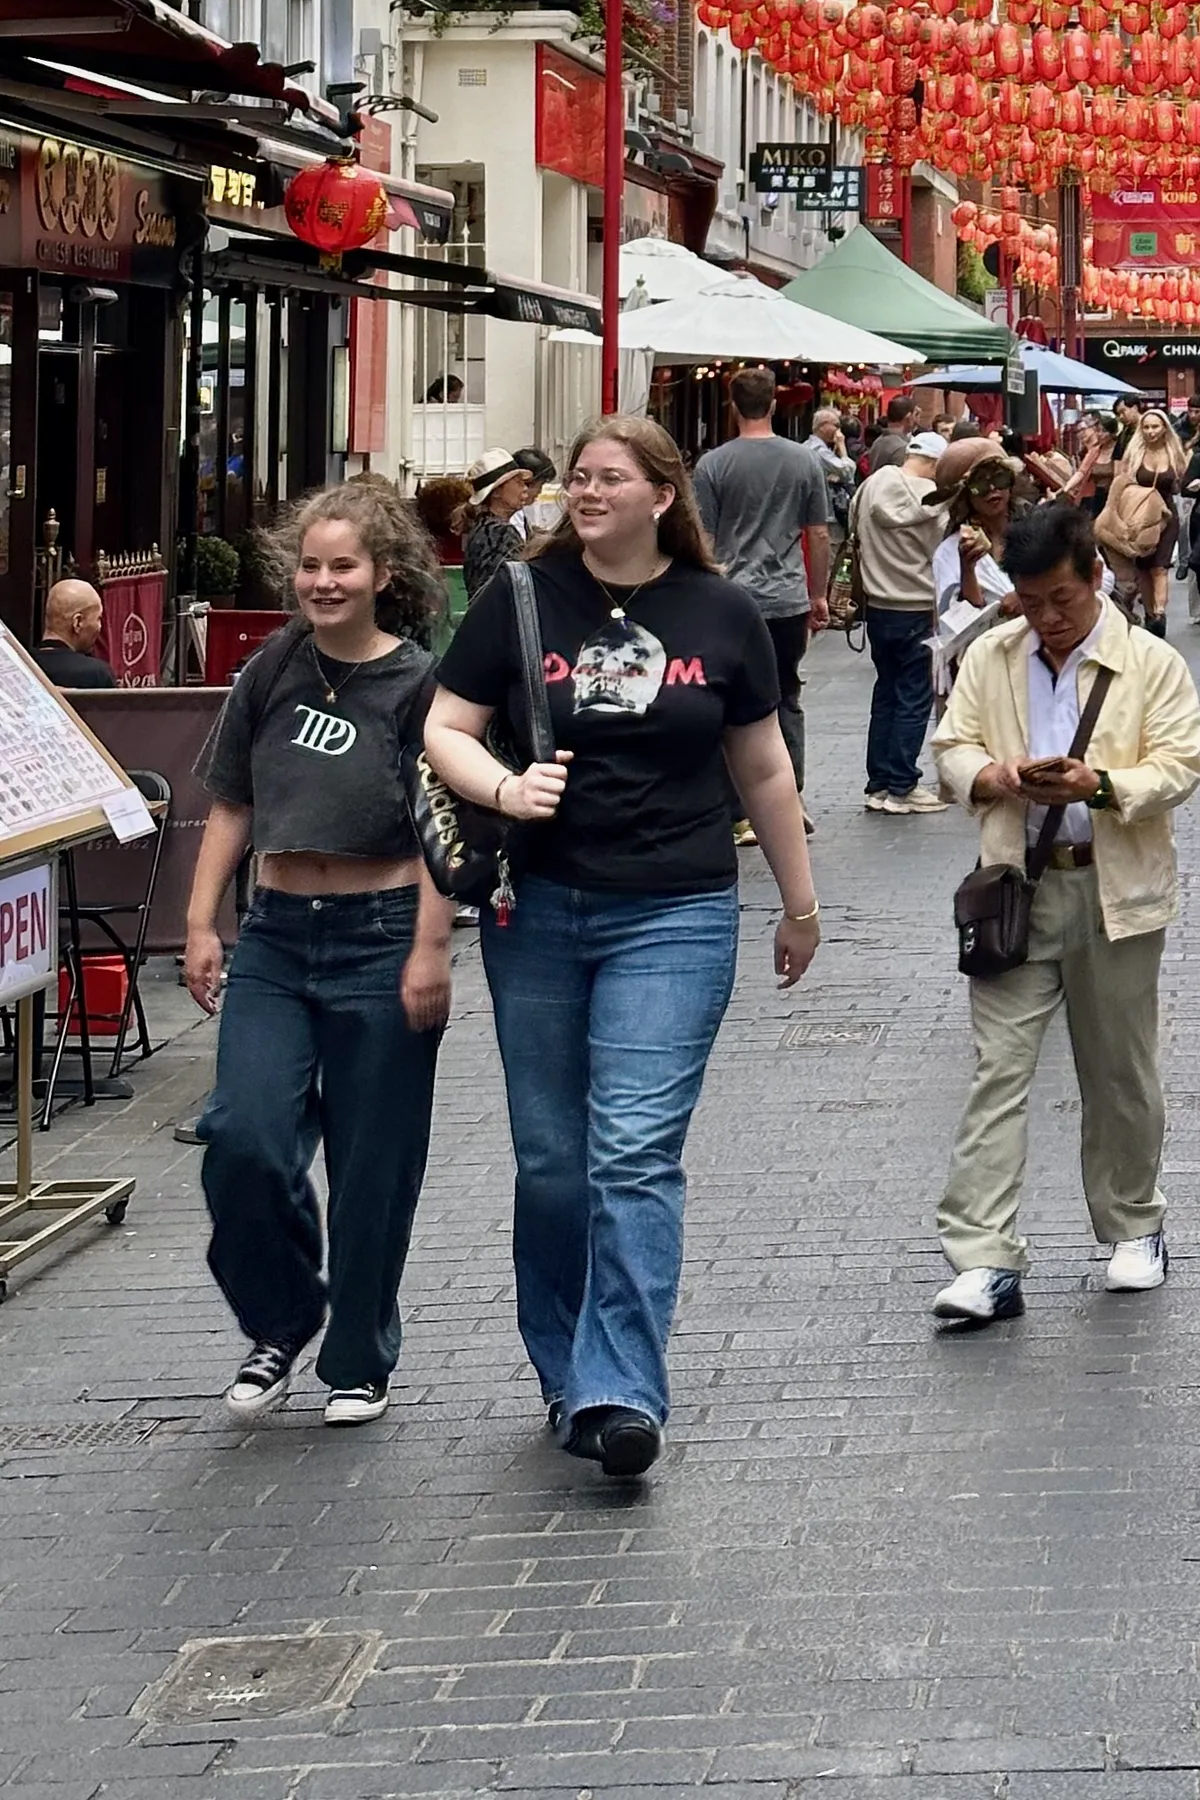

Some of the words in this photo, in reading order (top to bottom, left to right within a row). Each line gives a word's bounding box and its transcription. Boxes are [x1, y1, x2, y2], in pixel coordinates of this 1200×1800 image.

[762, 149, 826, 166] MIKO
[761, 167, 786, 175] HAIR
[792, 167, 827, 175] SALON
[821, 198, 845, 207] Salon
[1162, 191, 1198, 203] KUNG
[87, 840, 112, 851] EST
[0, 886, 48, 969] PEN
